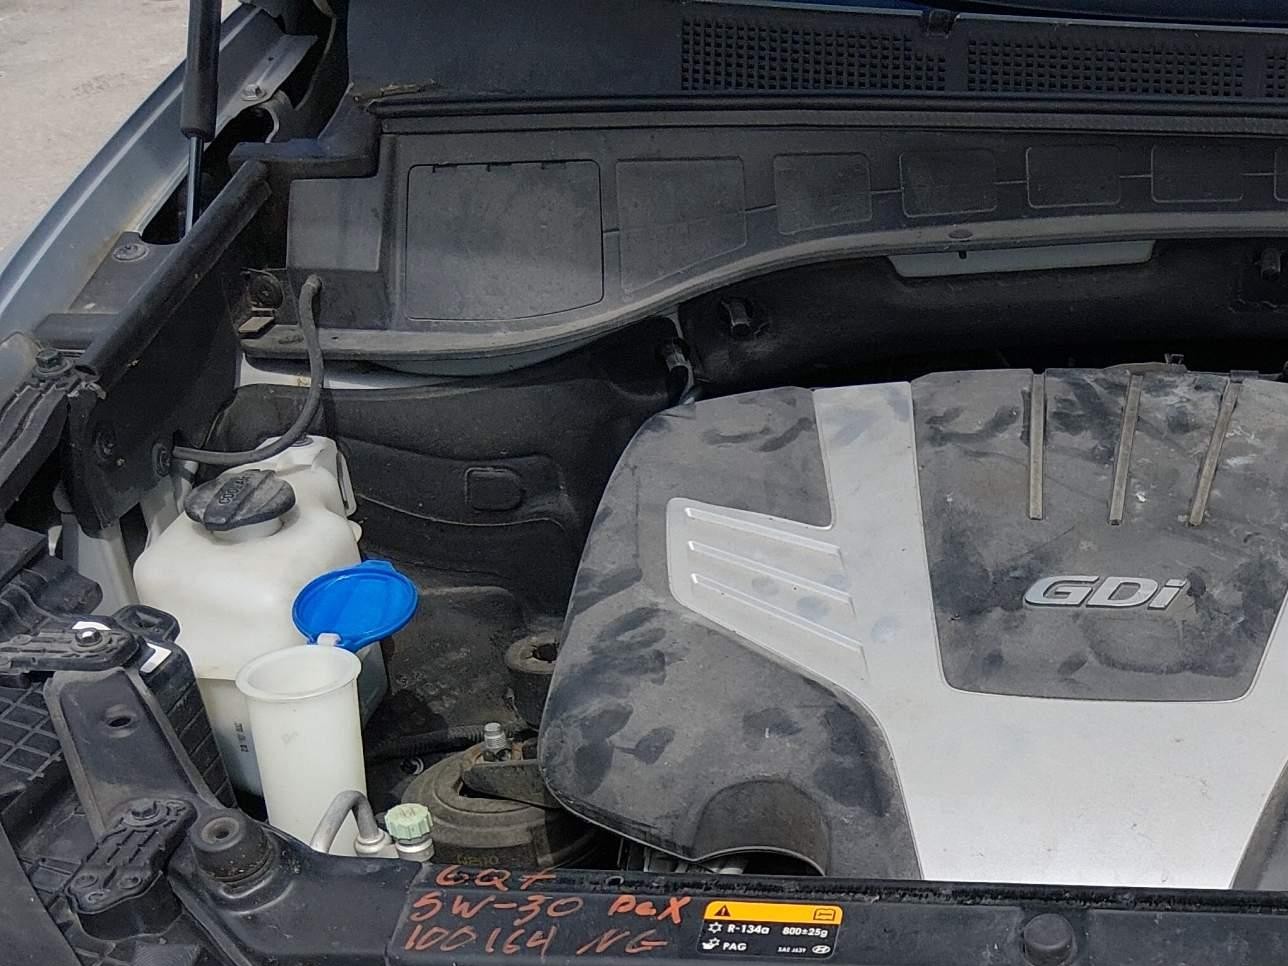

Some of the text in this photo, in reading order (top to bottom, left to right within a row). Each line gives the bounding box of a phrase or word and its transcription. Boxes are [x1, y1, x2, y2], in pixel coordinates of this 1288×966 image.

[1023, 576, 1187, 610] GDi
[727, 923, 829, 938] R-134a 800±25g
[722, 942, 748, 951] PAG
